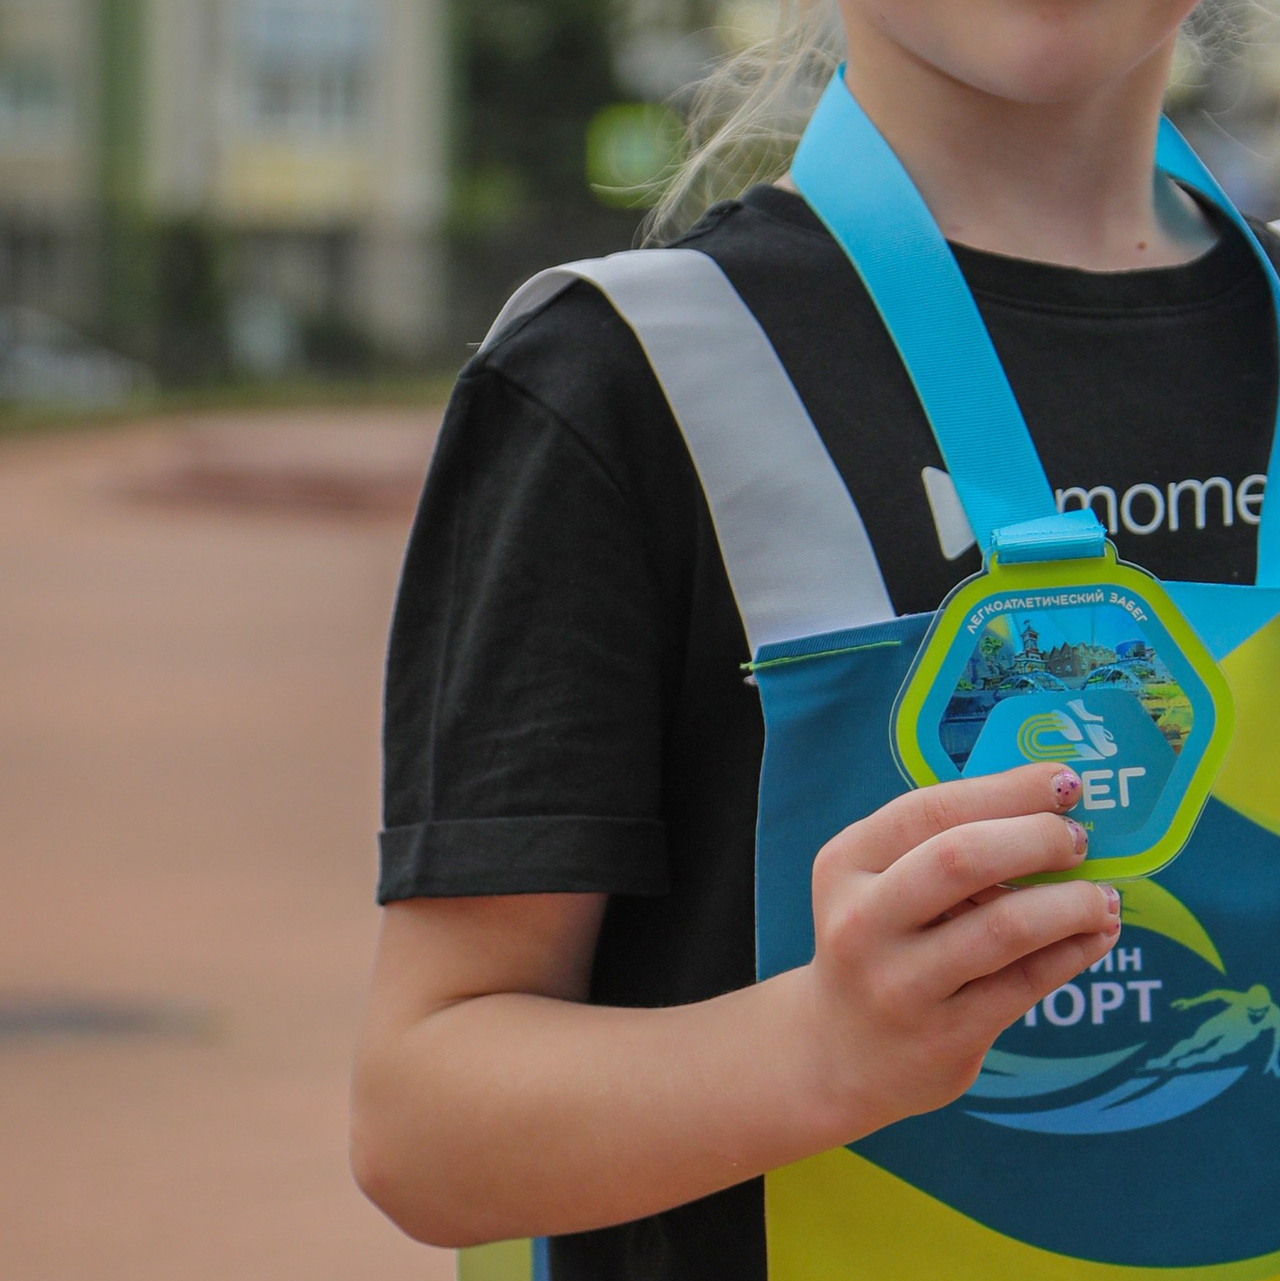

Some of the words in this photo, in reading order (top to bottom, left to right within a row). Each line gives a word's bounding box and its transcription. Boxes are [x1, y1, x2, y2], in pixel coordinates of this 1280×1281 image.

[967, 589, 1104, 634] ЛЕГКОАТЛЕТИЧЕСКИЙ
[1109, 592, 1148, 622] ЗАБЕГ
[1068, 766, 1146, 812] ЕГ
[1024, 979, 1163, 1027] ОРТ
